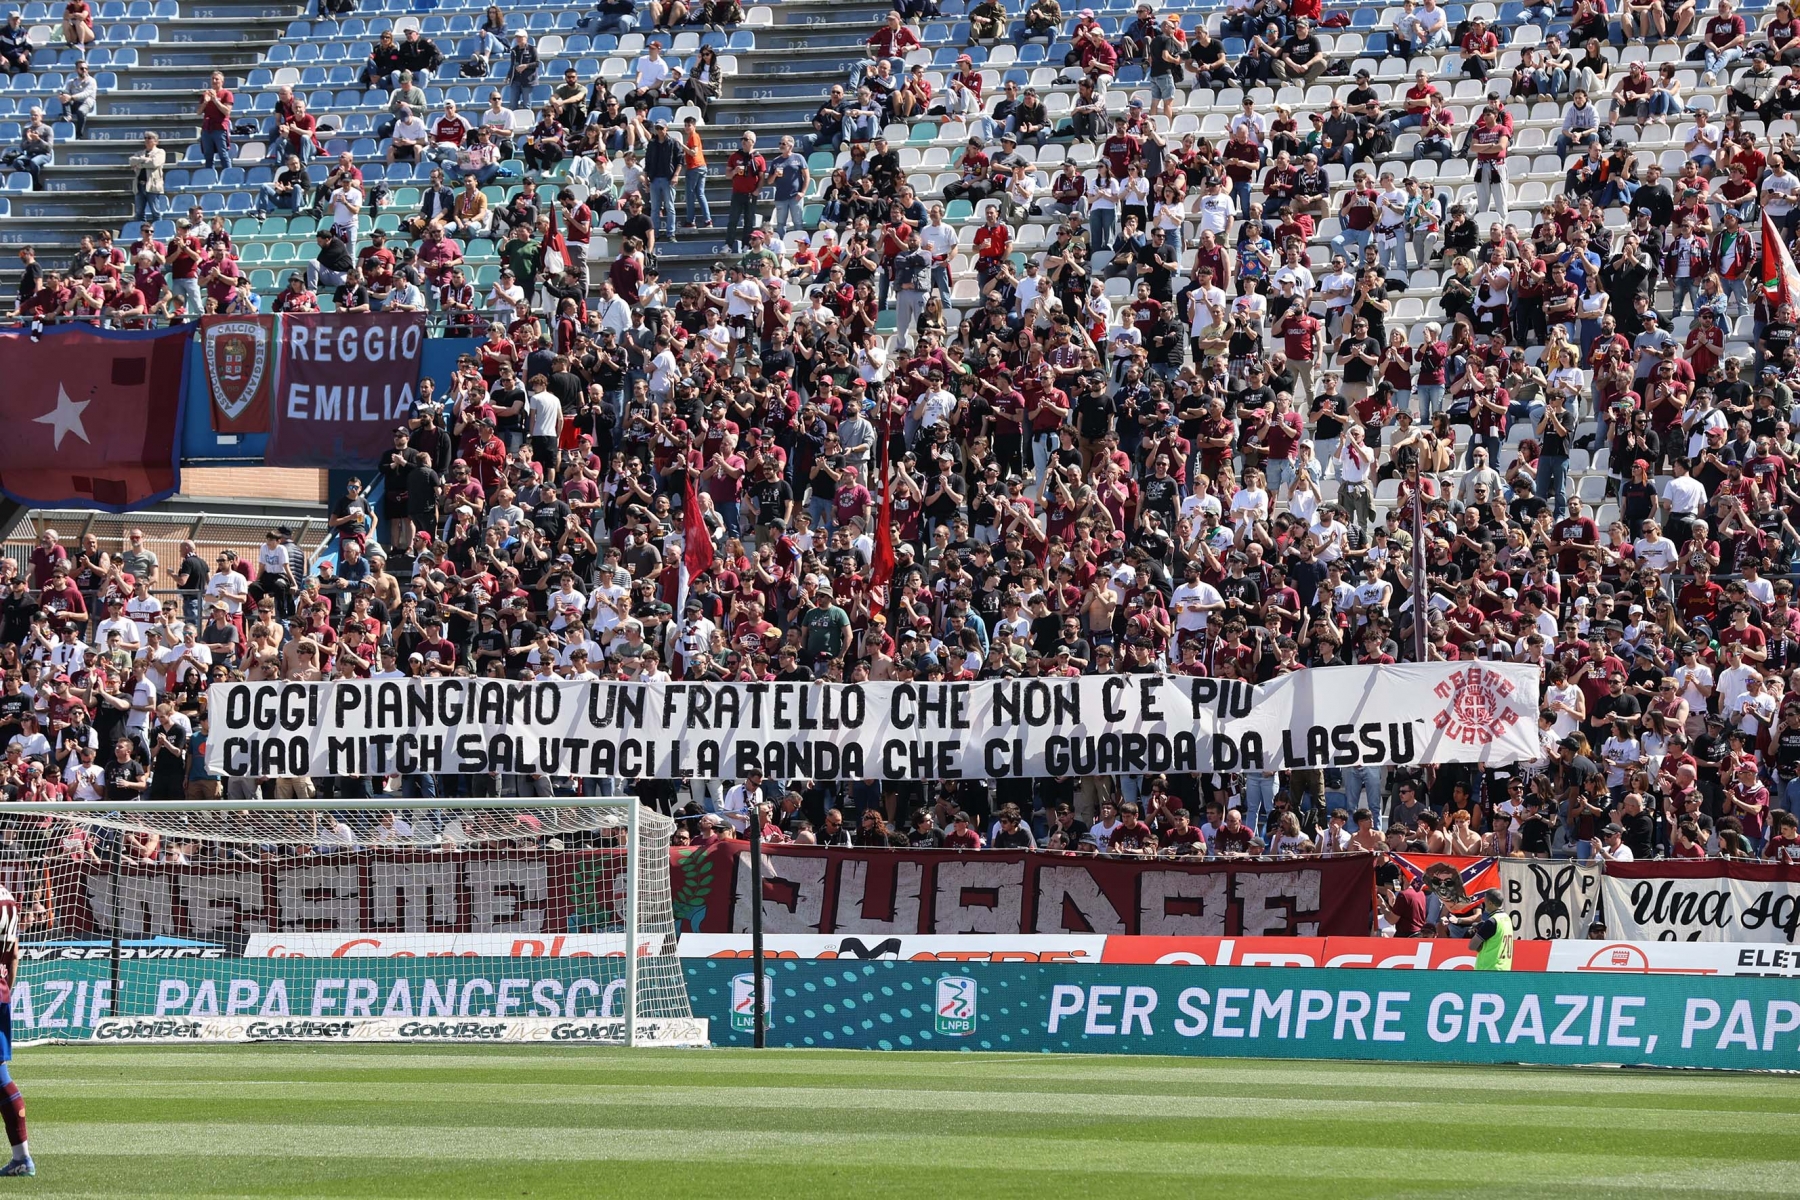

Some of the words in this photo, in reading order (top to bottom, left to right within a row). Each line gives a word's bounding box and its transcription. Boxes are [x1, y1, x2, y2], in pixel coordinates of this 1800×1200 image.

[202, 10, 214, 18] 25
[815, 15, 827, 24] 24
[797, 40, 809, 48] 23
[161, 58, 173, 66] 23
[779, 65, 791, 73] 22
[141, 82, 153, 90] 22
[761, 89, 773, 98] 21
[120, 107, 131, 115] 21
[99, 132, 110, 140] 20
[169, 131, 180, 139] 20
[727, 141, 738, 149] 19
[78, 157, 89, 165] 19
[55, 183, 67, 191] 18
[759, 190, 770, 199] 17
[34, 208, 45, 216] 17
[11, 234, 23, 242] 16
[217, 323, 257, 335] CALCIO
[291, 324, 421, 362] REGGIO
[207, 333, 233, 411] ASSOCIAZIONE
[287, 382, 414, 421] EMILIA
[1433, 667, 1516, 699] TESTE
[226, 684, 318, 731] OGGI
[335, 681, 561, 729] PIANGIAMO
[588, 682, 646, 729] UN
[662, 683, 865, 730] FRATELLO
[890, 683, 970, 729] CHE
[992, 680, 1080, 727] NON
[1432, 705, 1520, 746] QUADRE
[223, 735, 310, 777] CIAO
[328, 733, 443, 775] MITCH
[457, 733, 655, 778] SALUTACI
[670, 739, 720, 778] LA
[735, 740, 864, 779] BANDA
[882, 738, 962, 780] CHE
[984, 737, 1023, 777] CI
[1044, 730, 1197, 776] GUARDA
[1213, 730, 1264, 771] DA
[1630, 880, 1733, 929] Una
[1741, 890, 1800, 943] sq
[11, 978, 124, 1028] AZIE
[155, 978, 291, 1017] PAPA
[310, 977, 626, 1017] FRANCESCO
[1047, 984, 1159, 1036] PER
[1174, 986, 1411, 1042] SEMPRE
[1426, 991, 1659, 1054] GRAZIE,
[1680, 997, 1800, 1052] PAP
[246, 1020, 354, 1039] GoldBet
[941, 1020, 970, 1031] LNPB
